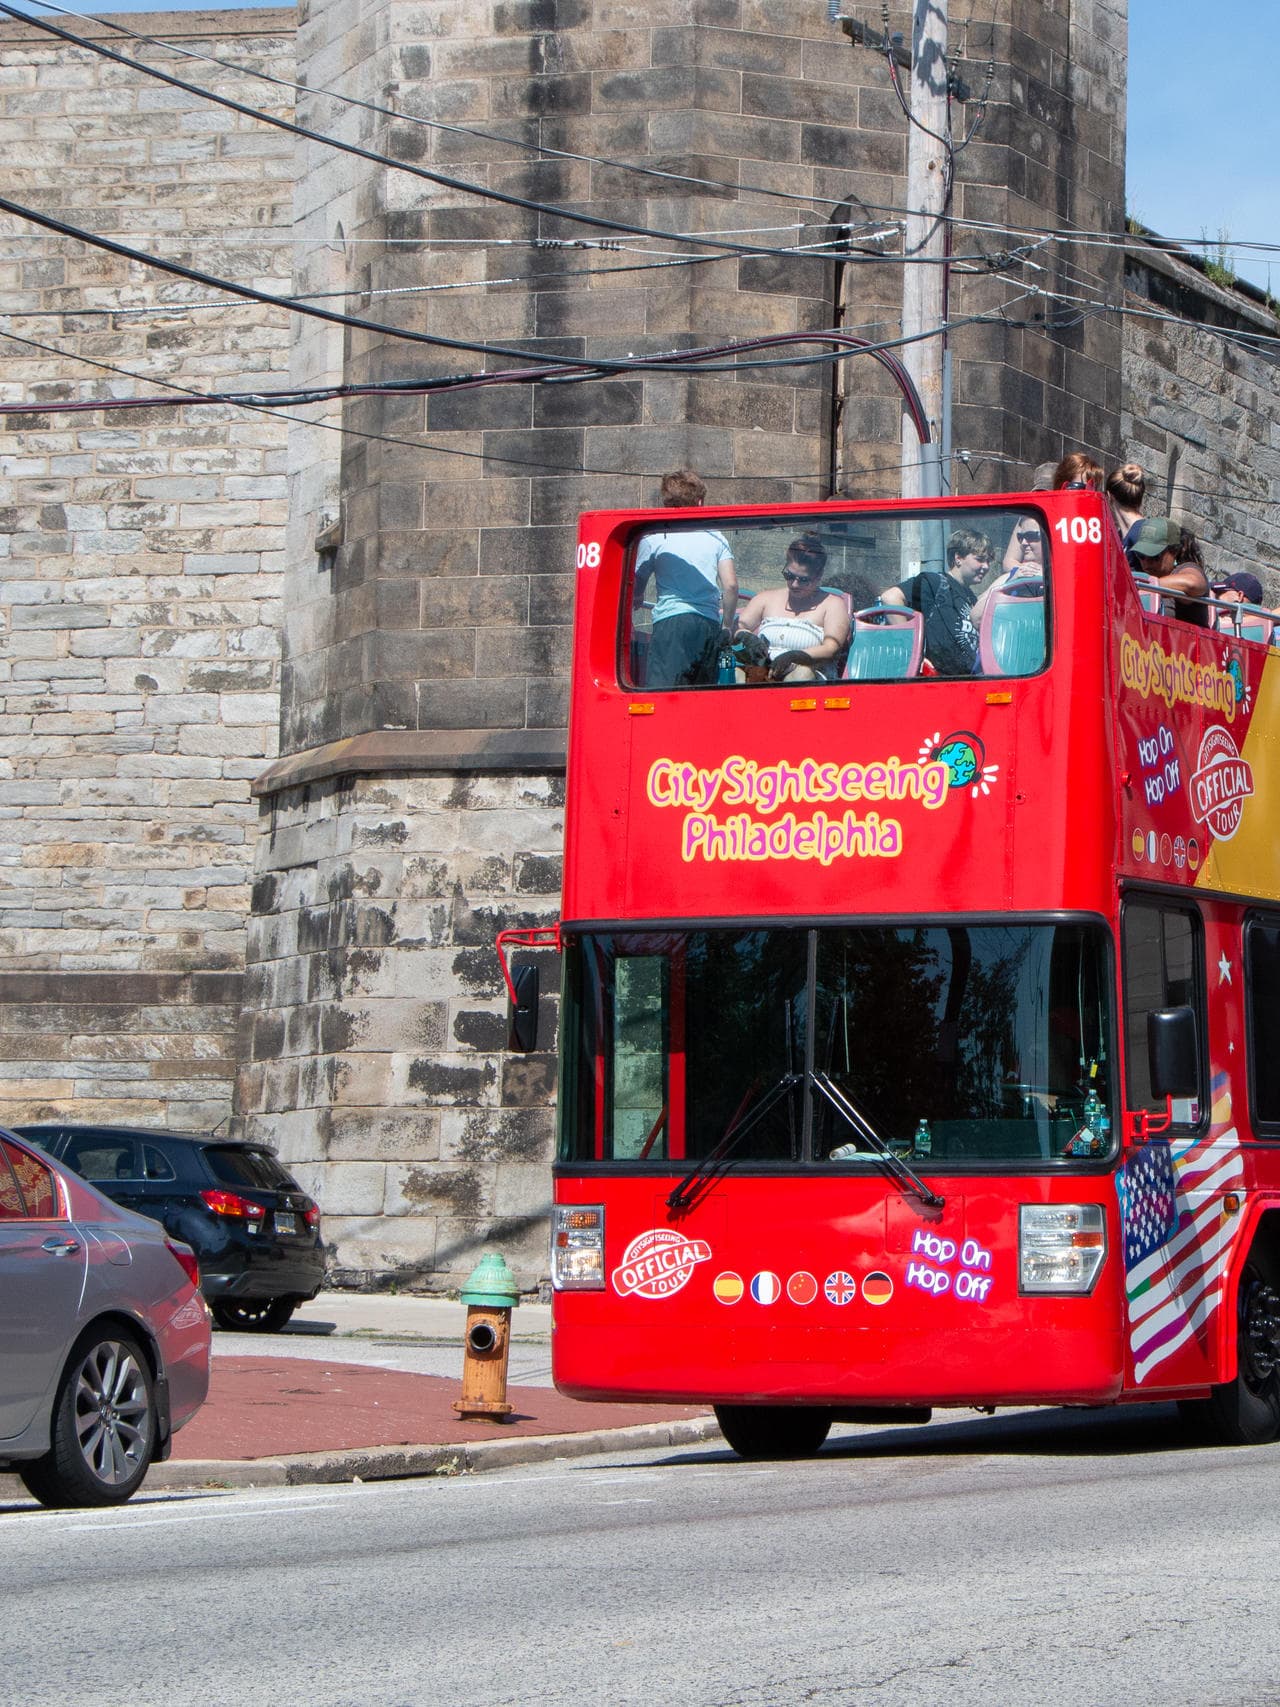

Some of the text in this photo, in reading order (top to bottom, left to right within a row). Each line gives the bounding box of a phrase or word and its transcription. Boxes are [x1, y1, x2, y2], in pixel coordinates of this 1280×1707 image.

[1055, 516, 1102, 543] 108
[576, 541, 601, 569] 08
[1138, 726, 1174, 767] Hop On
[1144, 759, 1180, 805] Hop Off
[1197, 765, 1251, 811] OFFICIAL
[1216, 803, 1240, 832] TOUR
[682, 809, 902, 866] Philadelphia
[622, 1243, 706, 1289] OFFICIAL
[913, 1230, 991, 1269] Hop On
[651, 1269, 688, 1293] TOUR
[907, 1262, 992, 1301] Hop Off
